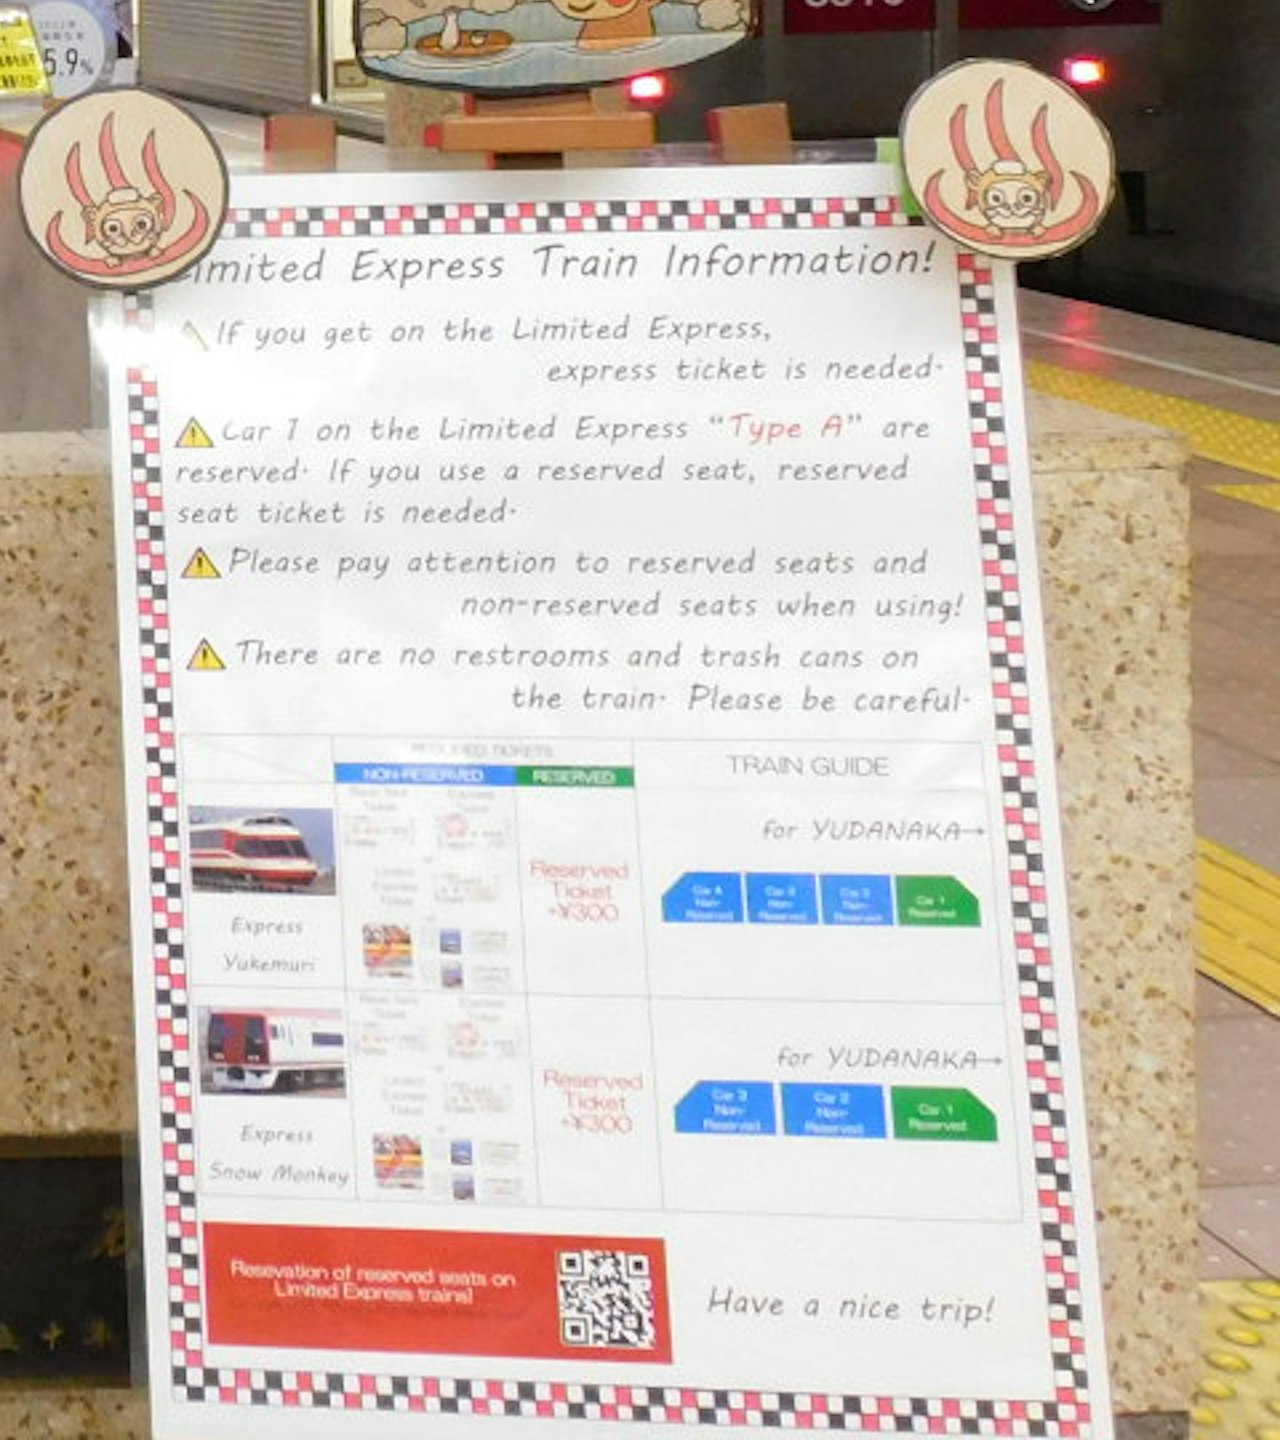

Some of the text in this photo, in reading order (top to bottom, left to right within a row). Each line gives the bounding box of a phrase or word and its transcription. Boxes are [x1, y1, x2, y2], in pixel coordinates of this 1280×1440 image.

[183, 240, 937, 287] imited Express Train Information!
[217, 314, 772, 348] If you get on the Limited Express,
[316, 422, 352, 441] on
[370, 417, 420, 440] the
[440, 415, 555, 440] Limited
[575, 415, 689, 444] Express
[883, 418, 930, 439] are
[330, 459, 353, 486] If
[370, 462, 418, 487] you
[440, 463, 486, 483] use
[503, 463, 519, 482] a
[538, 458, 664, 483] reserved
[682, 459, 755, 486] seat,
[778, 456, 908, 482] reserved
[177, 502, 237, 524] seat
[259, 499, 344, 524] ticket
[364, 500, 384, 523] is
[229, 548, 926, 581] Please pay attention to reserved seats and
[461, 592, 963, 622] non-reserved seats when using!
[513, 687, 562, 709] the
[688, 687, 783, 711] Please
[803, 687, 836, 711] be
[727, 754, 891, 777] TRAIN GUIDE
[762, 820, 961, 841] for YUDANAKA
[231, 918, 304, 937] Express
[211, 1164, 350, 1188] Snow Monkey
[709, 1286, 997, 1328] Have a nice trip!
